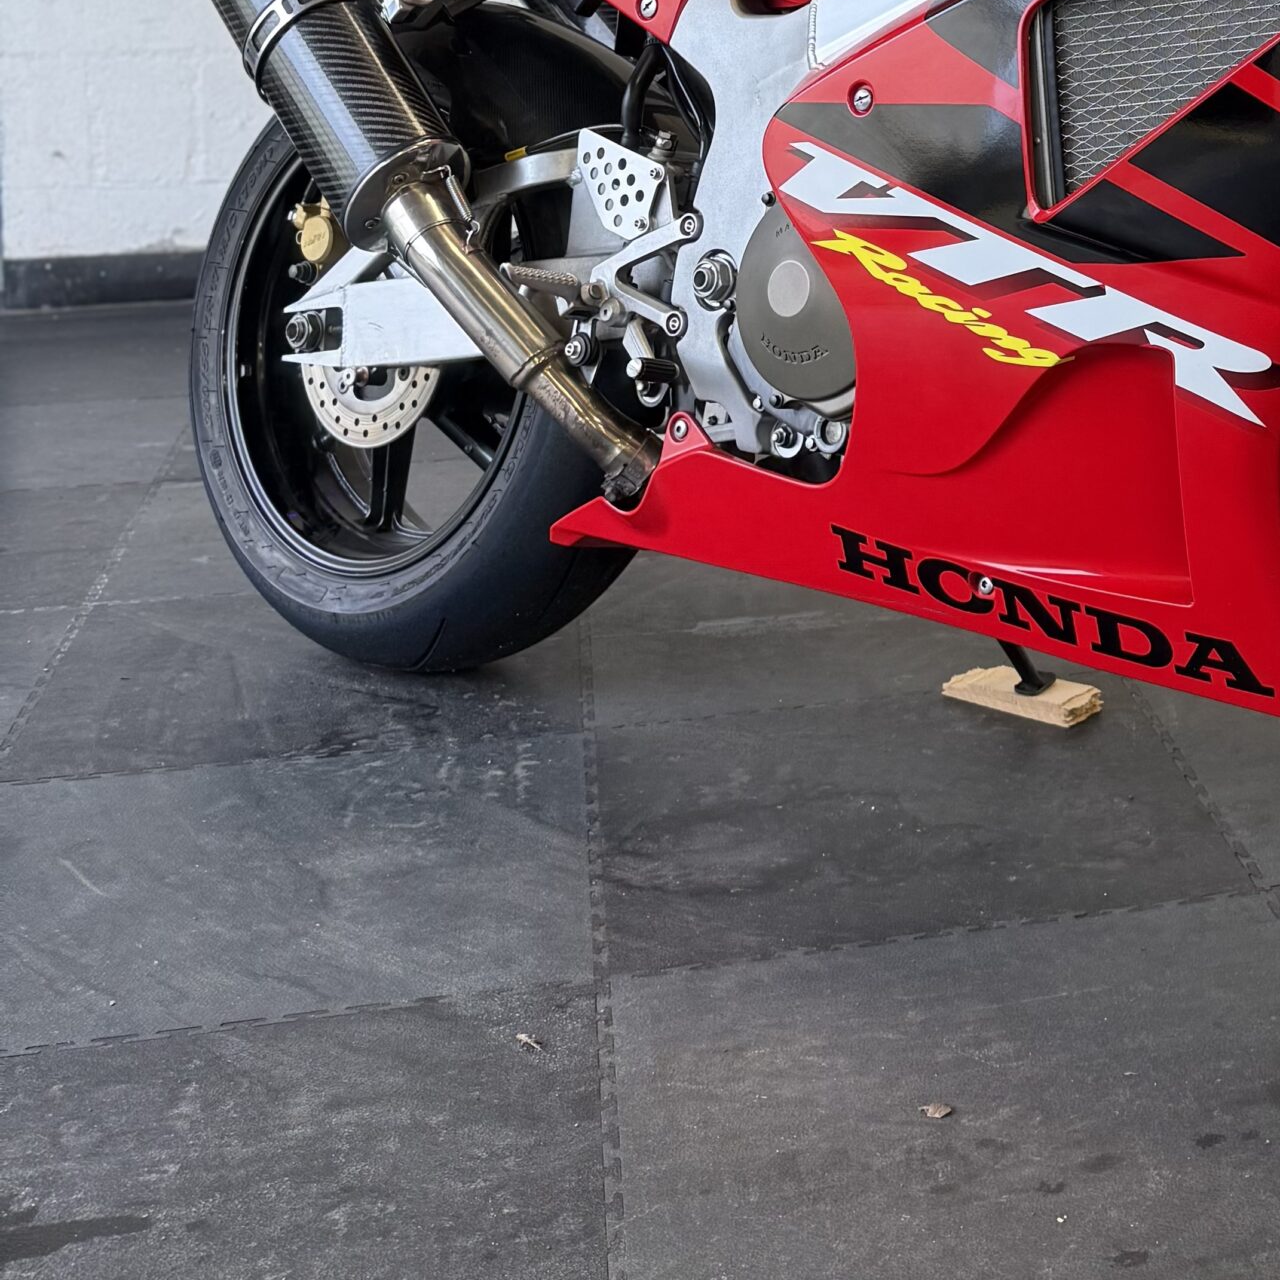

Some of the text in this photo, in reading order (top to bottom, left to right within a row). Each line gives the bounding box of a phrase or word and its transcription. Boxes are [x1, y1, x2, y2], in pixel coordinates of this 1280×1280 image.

[779, 141, 1274, 428] VTR
[811, 228, 1075, 367] Racing
[830, 522, 1275, 698] HONDA
